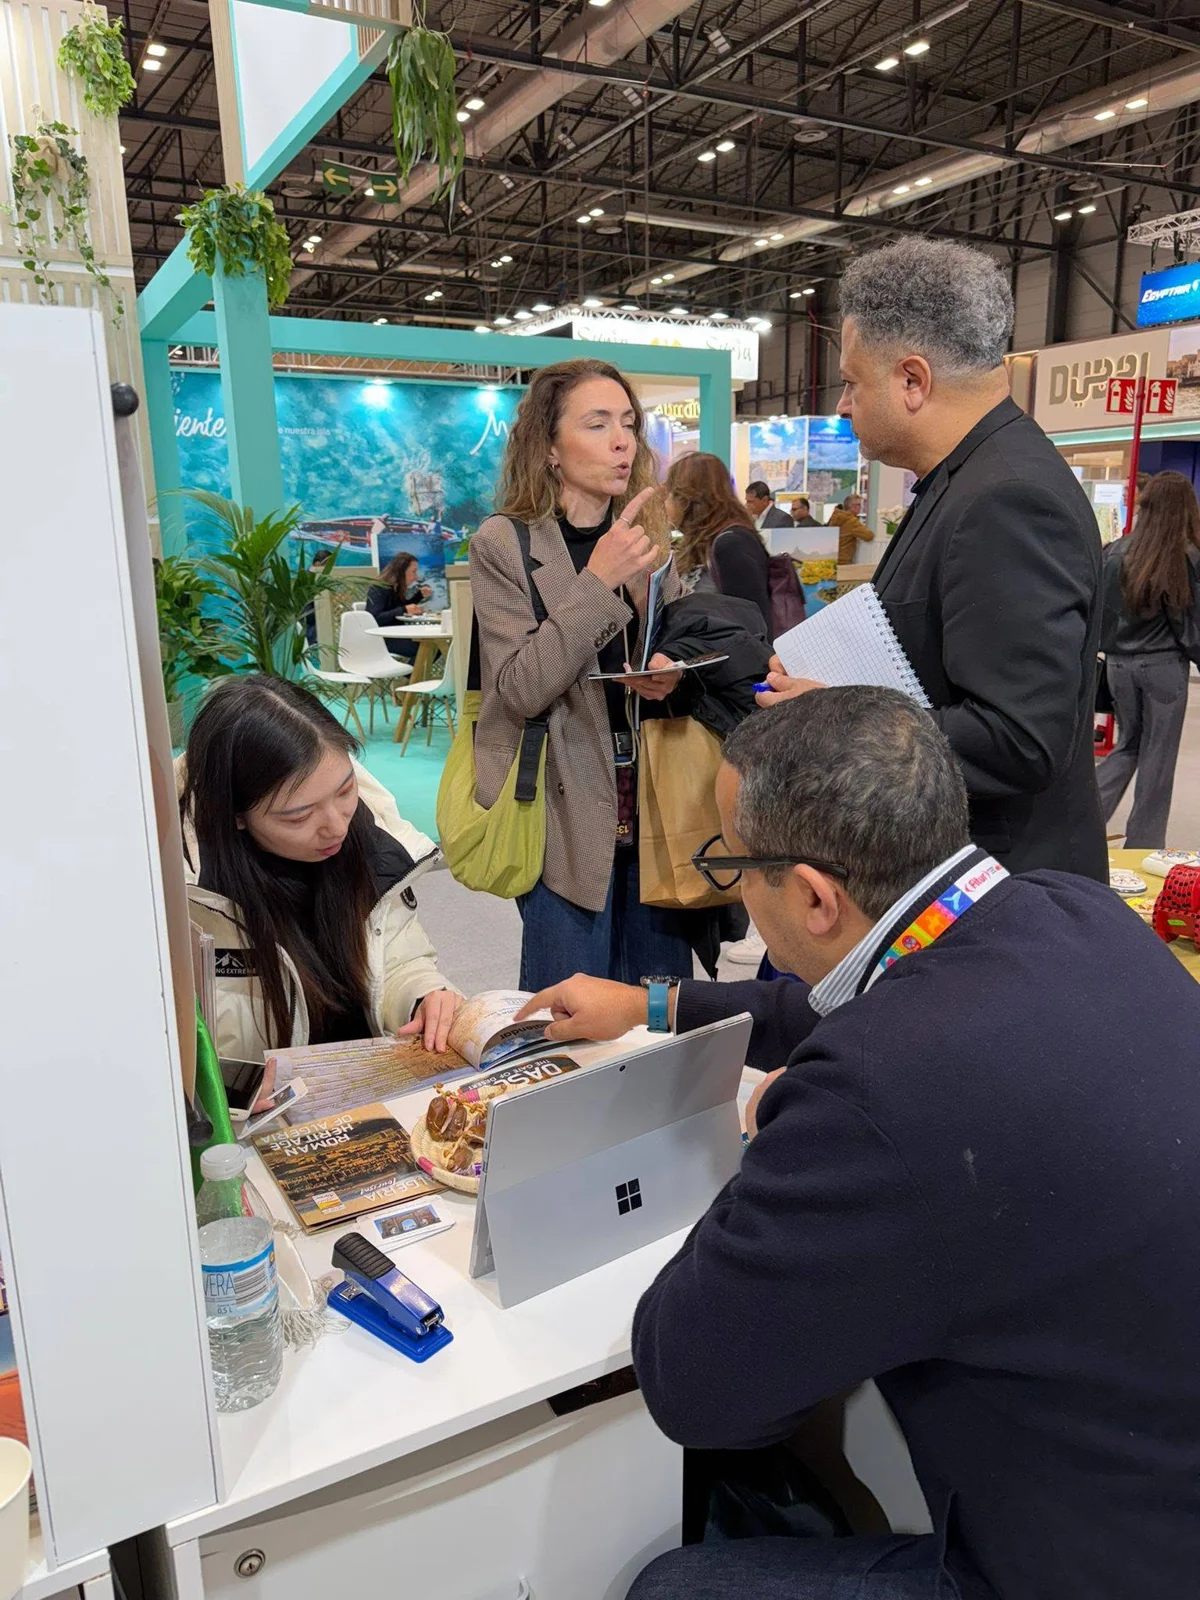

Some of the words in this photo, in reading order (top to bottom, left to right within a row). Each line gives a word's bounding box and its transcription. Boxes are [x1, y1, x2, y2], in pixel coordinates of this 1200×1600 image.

[173, 407, 227, 437] iente
[226, 967, 257, 975] EXTREE
[535, 1059, 552, 1067] THE
[499, 1071, 511, 1079] OF
[334, 1113, 354, 1127] OF
[260, 1121, 328, 1144] ALGERIA
[269, 1123, 355, 1152] HERITAGE
[284, 1133, 351, 1157] ROMAN
[363, 1175, 430, 1203] LGERIA
